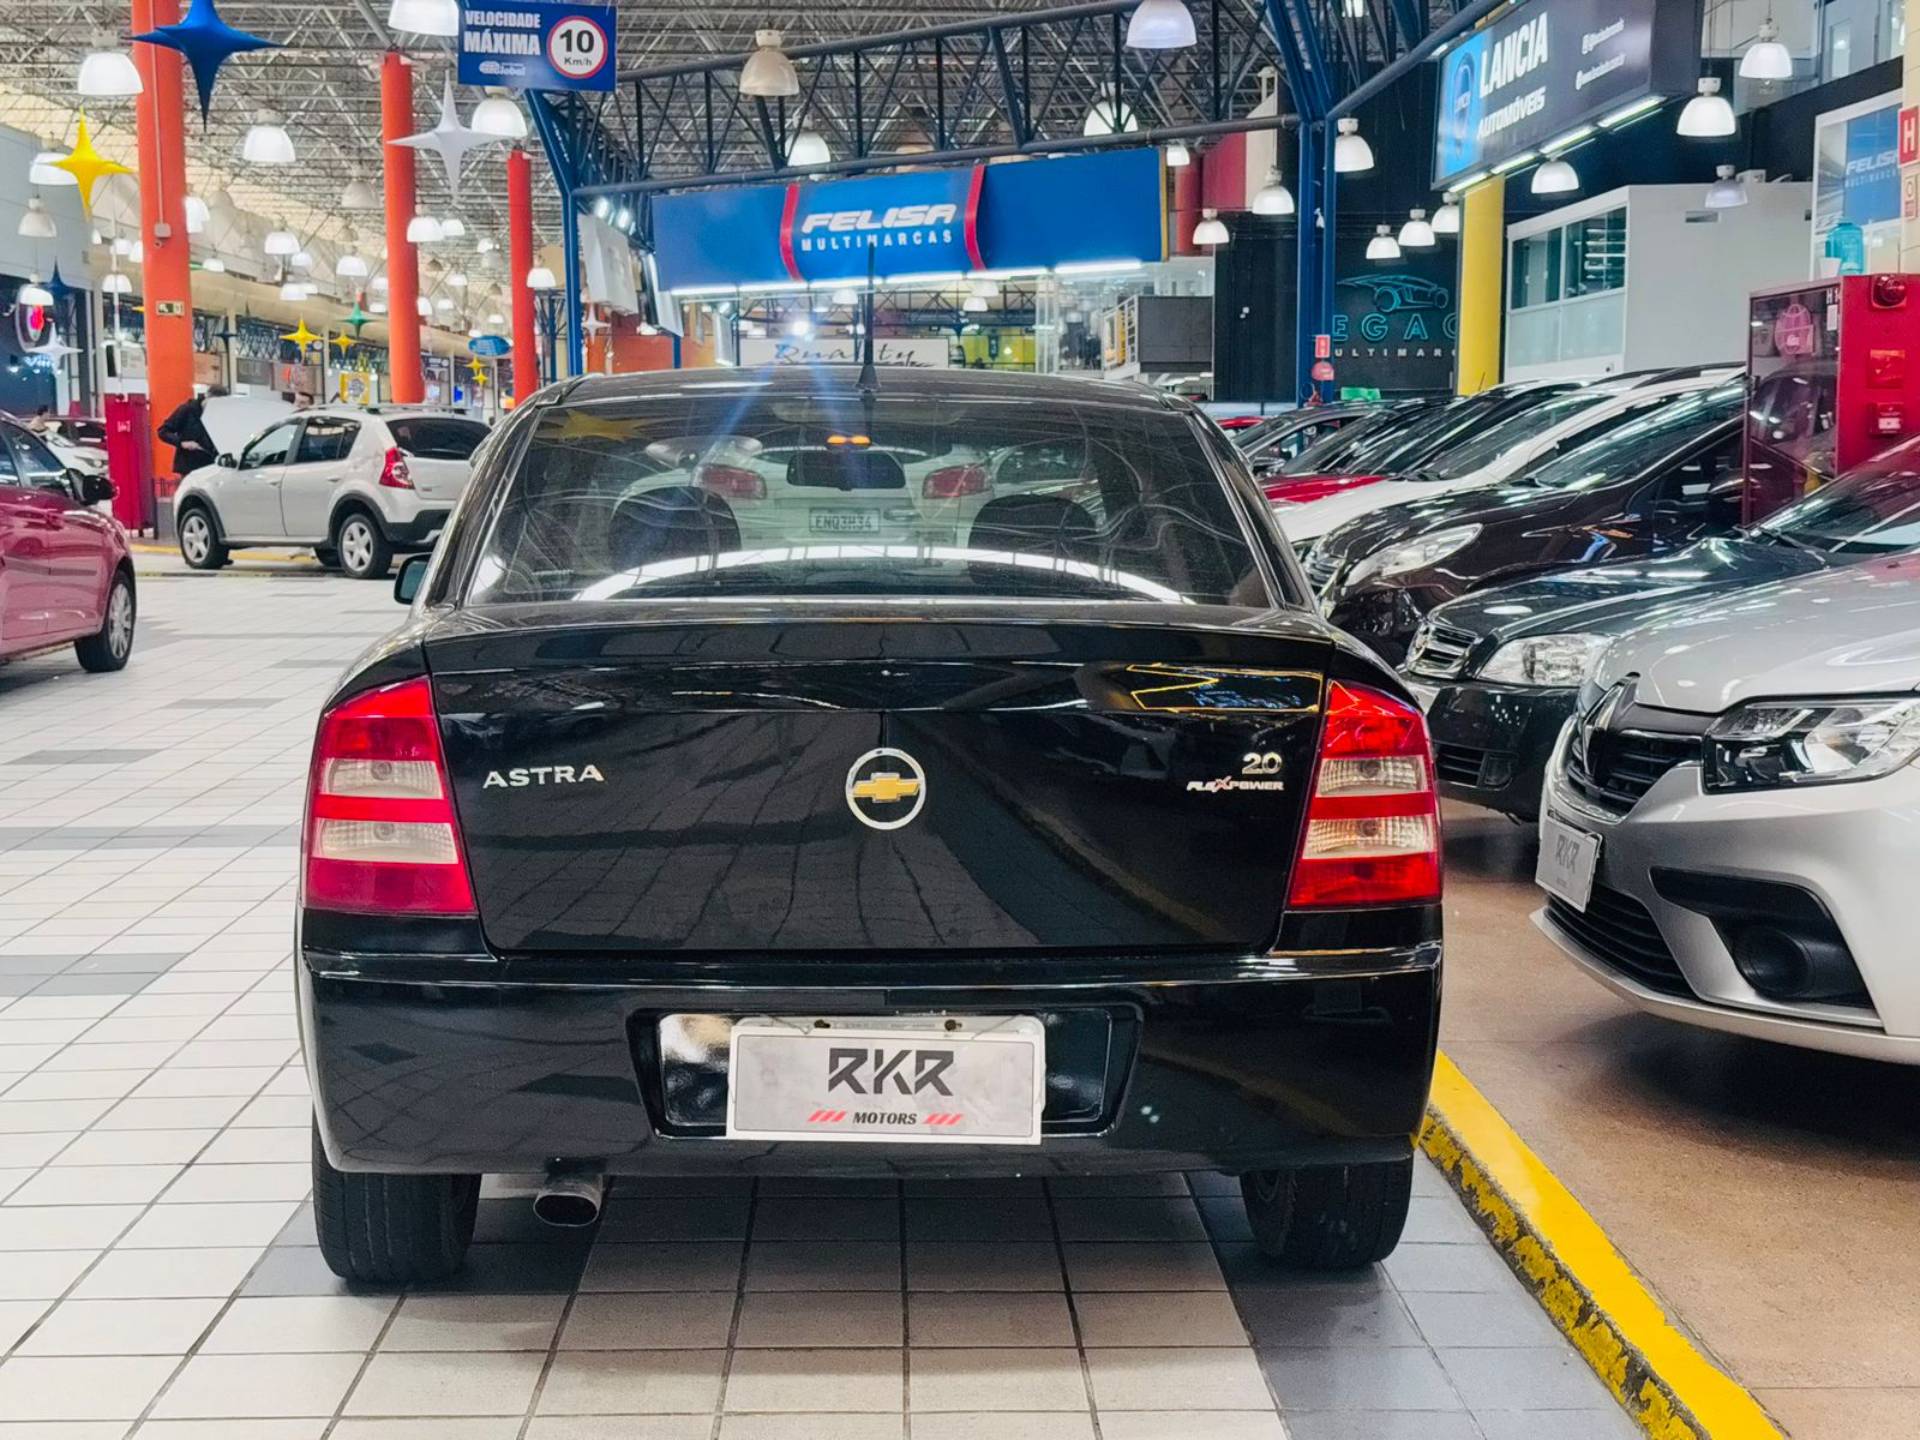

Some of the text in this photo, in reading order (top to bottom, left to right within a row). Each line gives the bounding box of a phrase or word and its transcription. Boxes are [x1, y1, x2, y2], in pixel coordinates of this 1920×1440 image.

[465, 10, 541, 28] VELOCIDADE
[464, 28, 541, 56] MÁXIMA
[559, 29, 595, 54] 10
[1479, 12, 1548, 98] LANCIA
[563, 57, 593, 67] Km/h
[1476, 86, 1546, 141] AUTOMÓVEIS
[1902, 116, 1916, 154] H
[801, 203, 957, 234] FELISA
[801, 229, 953, 252] MULTIMARCAS
[774, 339, 920, 366] Qualty
[482, 764, 605, 789] ASTRA
[828, 1047, 954, 1097] RKR
[852, 1111, 918, 1126] MOTORS
